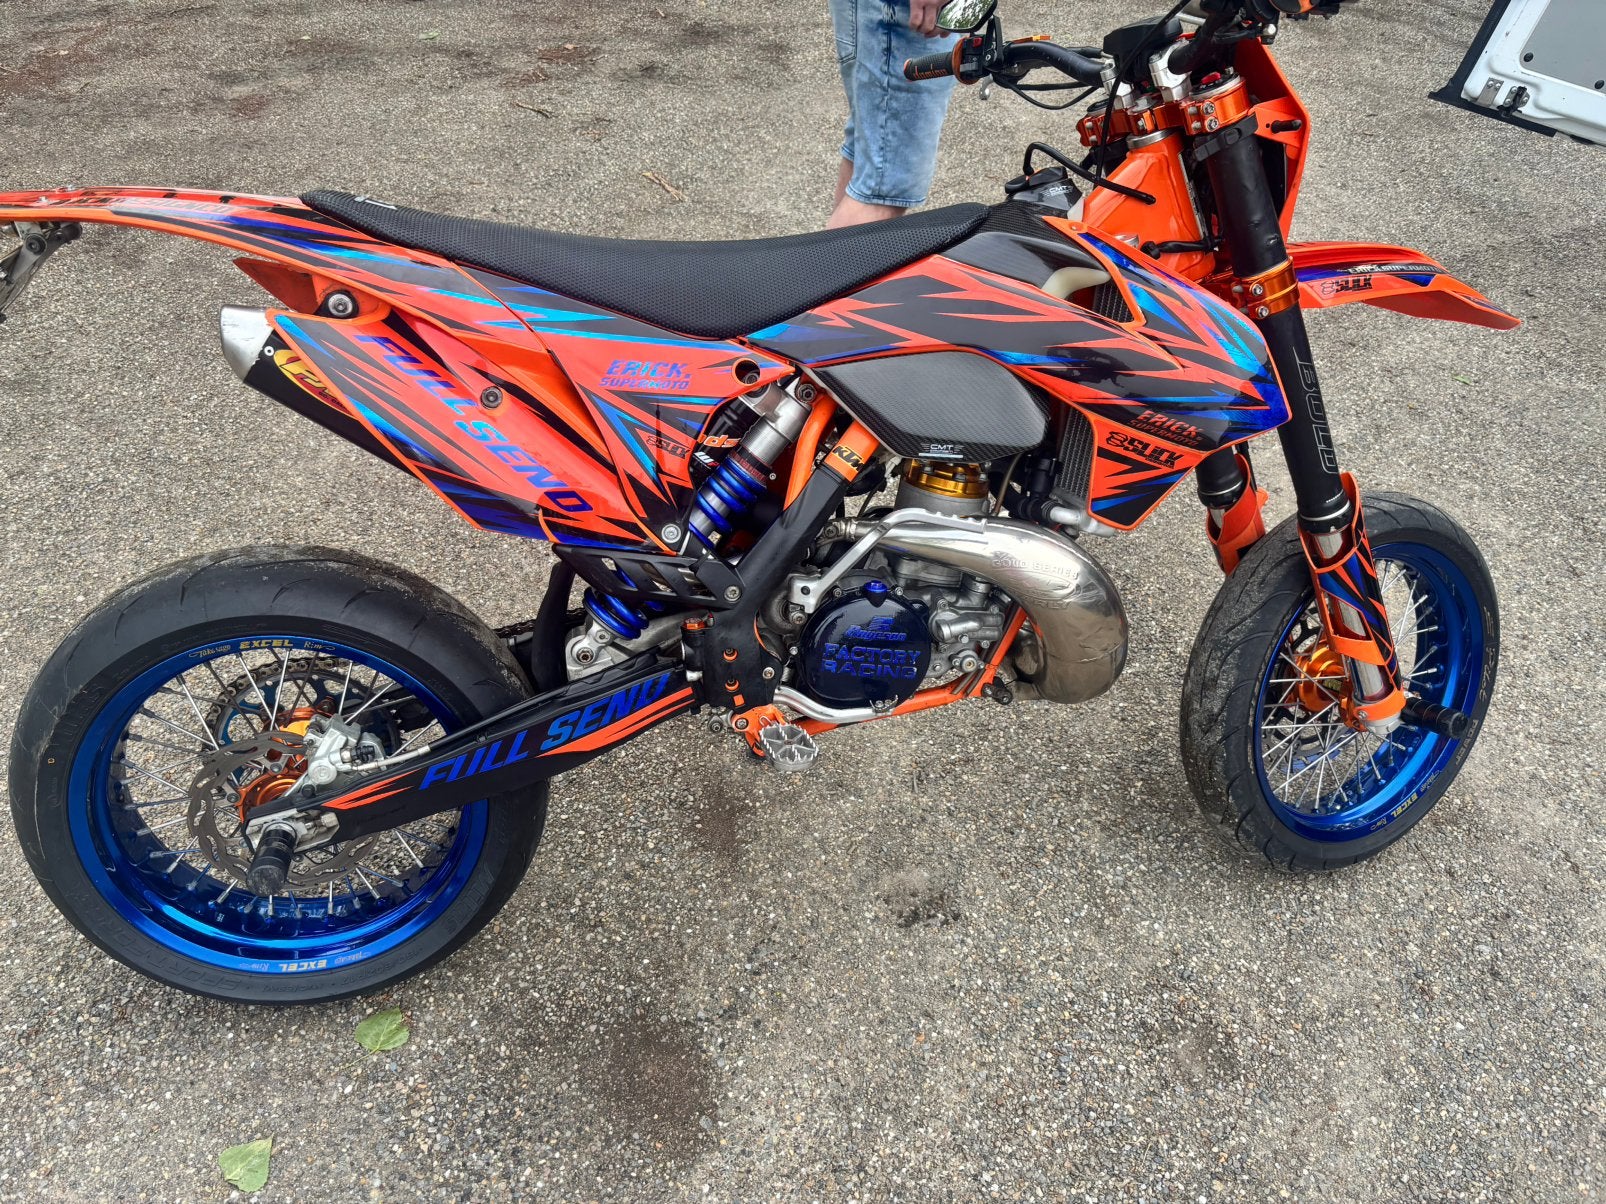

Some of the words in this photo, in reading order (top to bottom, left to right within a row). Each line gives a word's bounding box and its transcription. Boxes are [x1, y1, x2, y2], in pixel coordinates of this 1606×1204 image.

[599, 377, 690, 390] SUPERMOTO
[1292, 346, 1339, 475] BOLD
[356, 334, 480, 416] FULL
[454, 418, 593, 513] SEND
[832, 445, 865, 472] KTM
[239, 639, 294, 650] EXCEL
[824, 642, 921, 665] FACTORY
[822, 659, 918, 679] RACING
[418, 730, 529, 790] FULL
[539, 673, 671, 751] SEND
[278, 959, 328, 973] EXCEL
